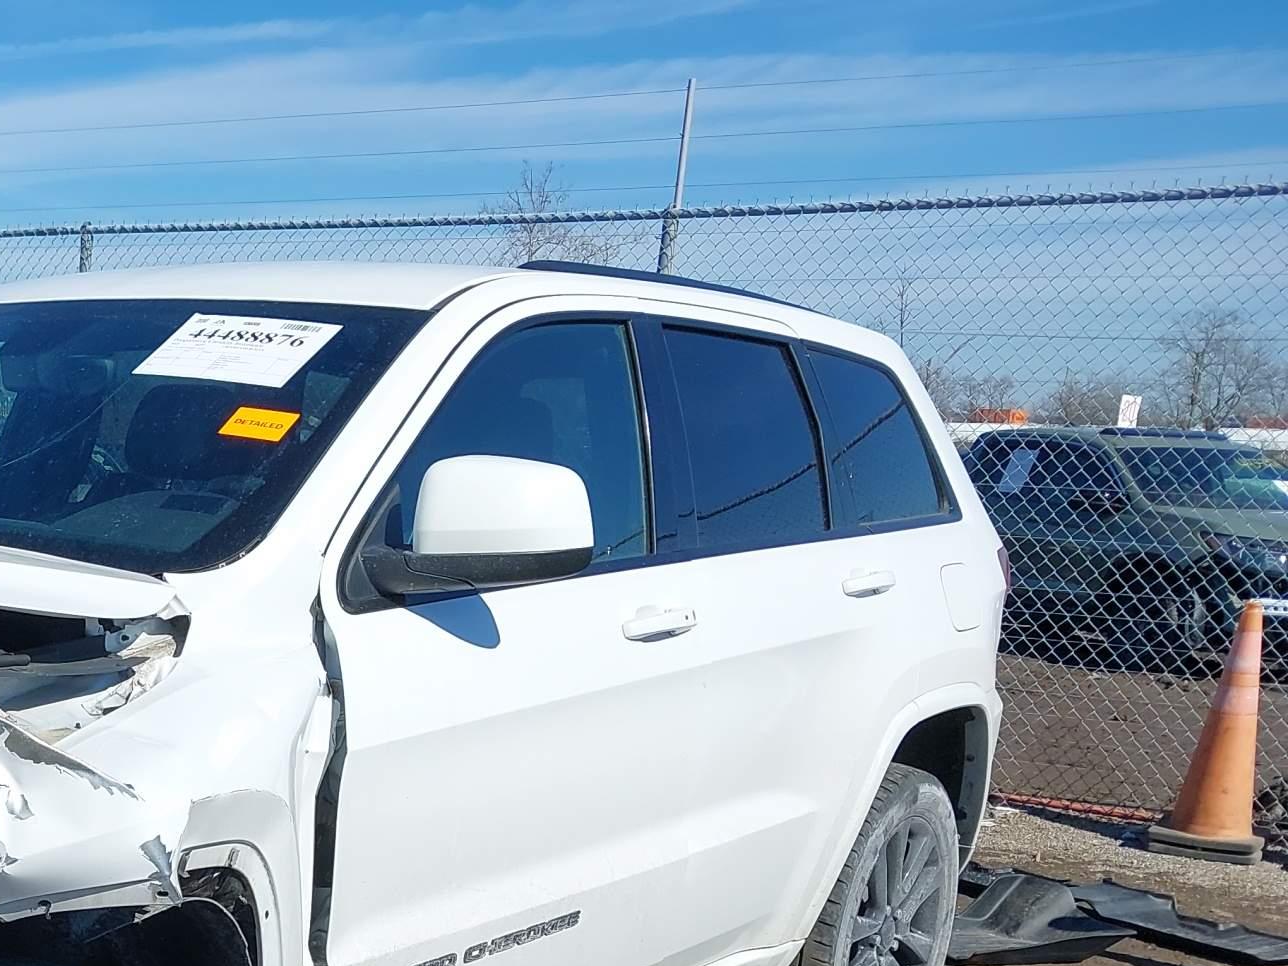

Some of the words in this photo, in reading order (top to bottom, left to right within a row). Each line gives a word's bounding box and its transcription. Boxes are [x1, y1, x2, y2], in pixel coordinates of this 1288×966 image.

[189, 327, 306, 348] 44488876
[233, 418, 284, 430] DETAILED
[463, 910, 581, 964] CHEROKEE
